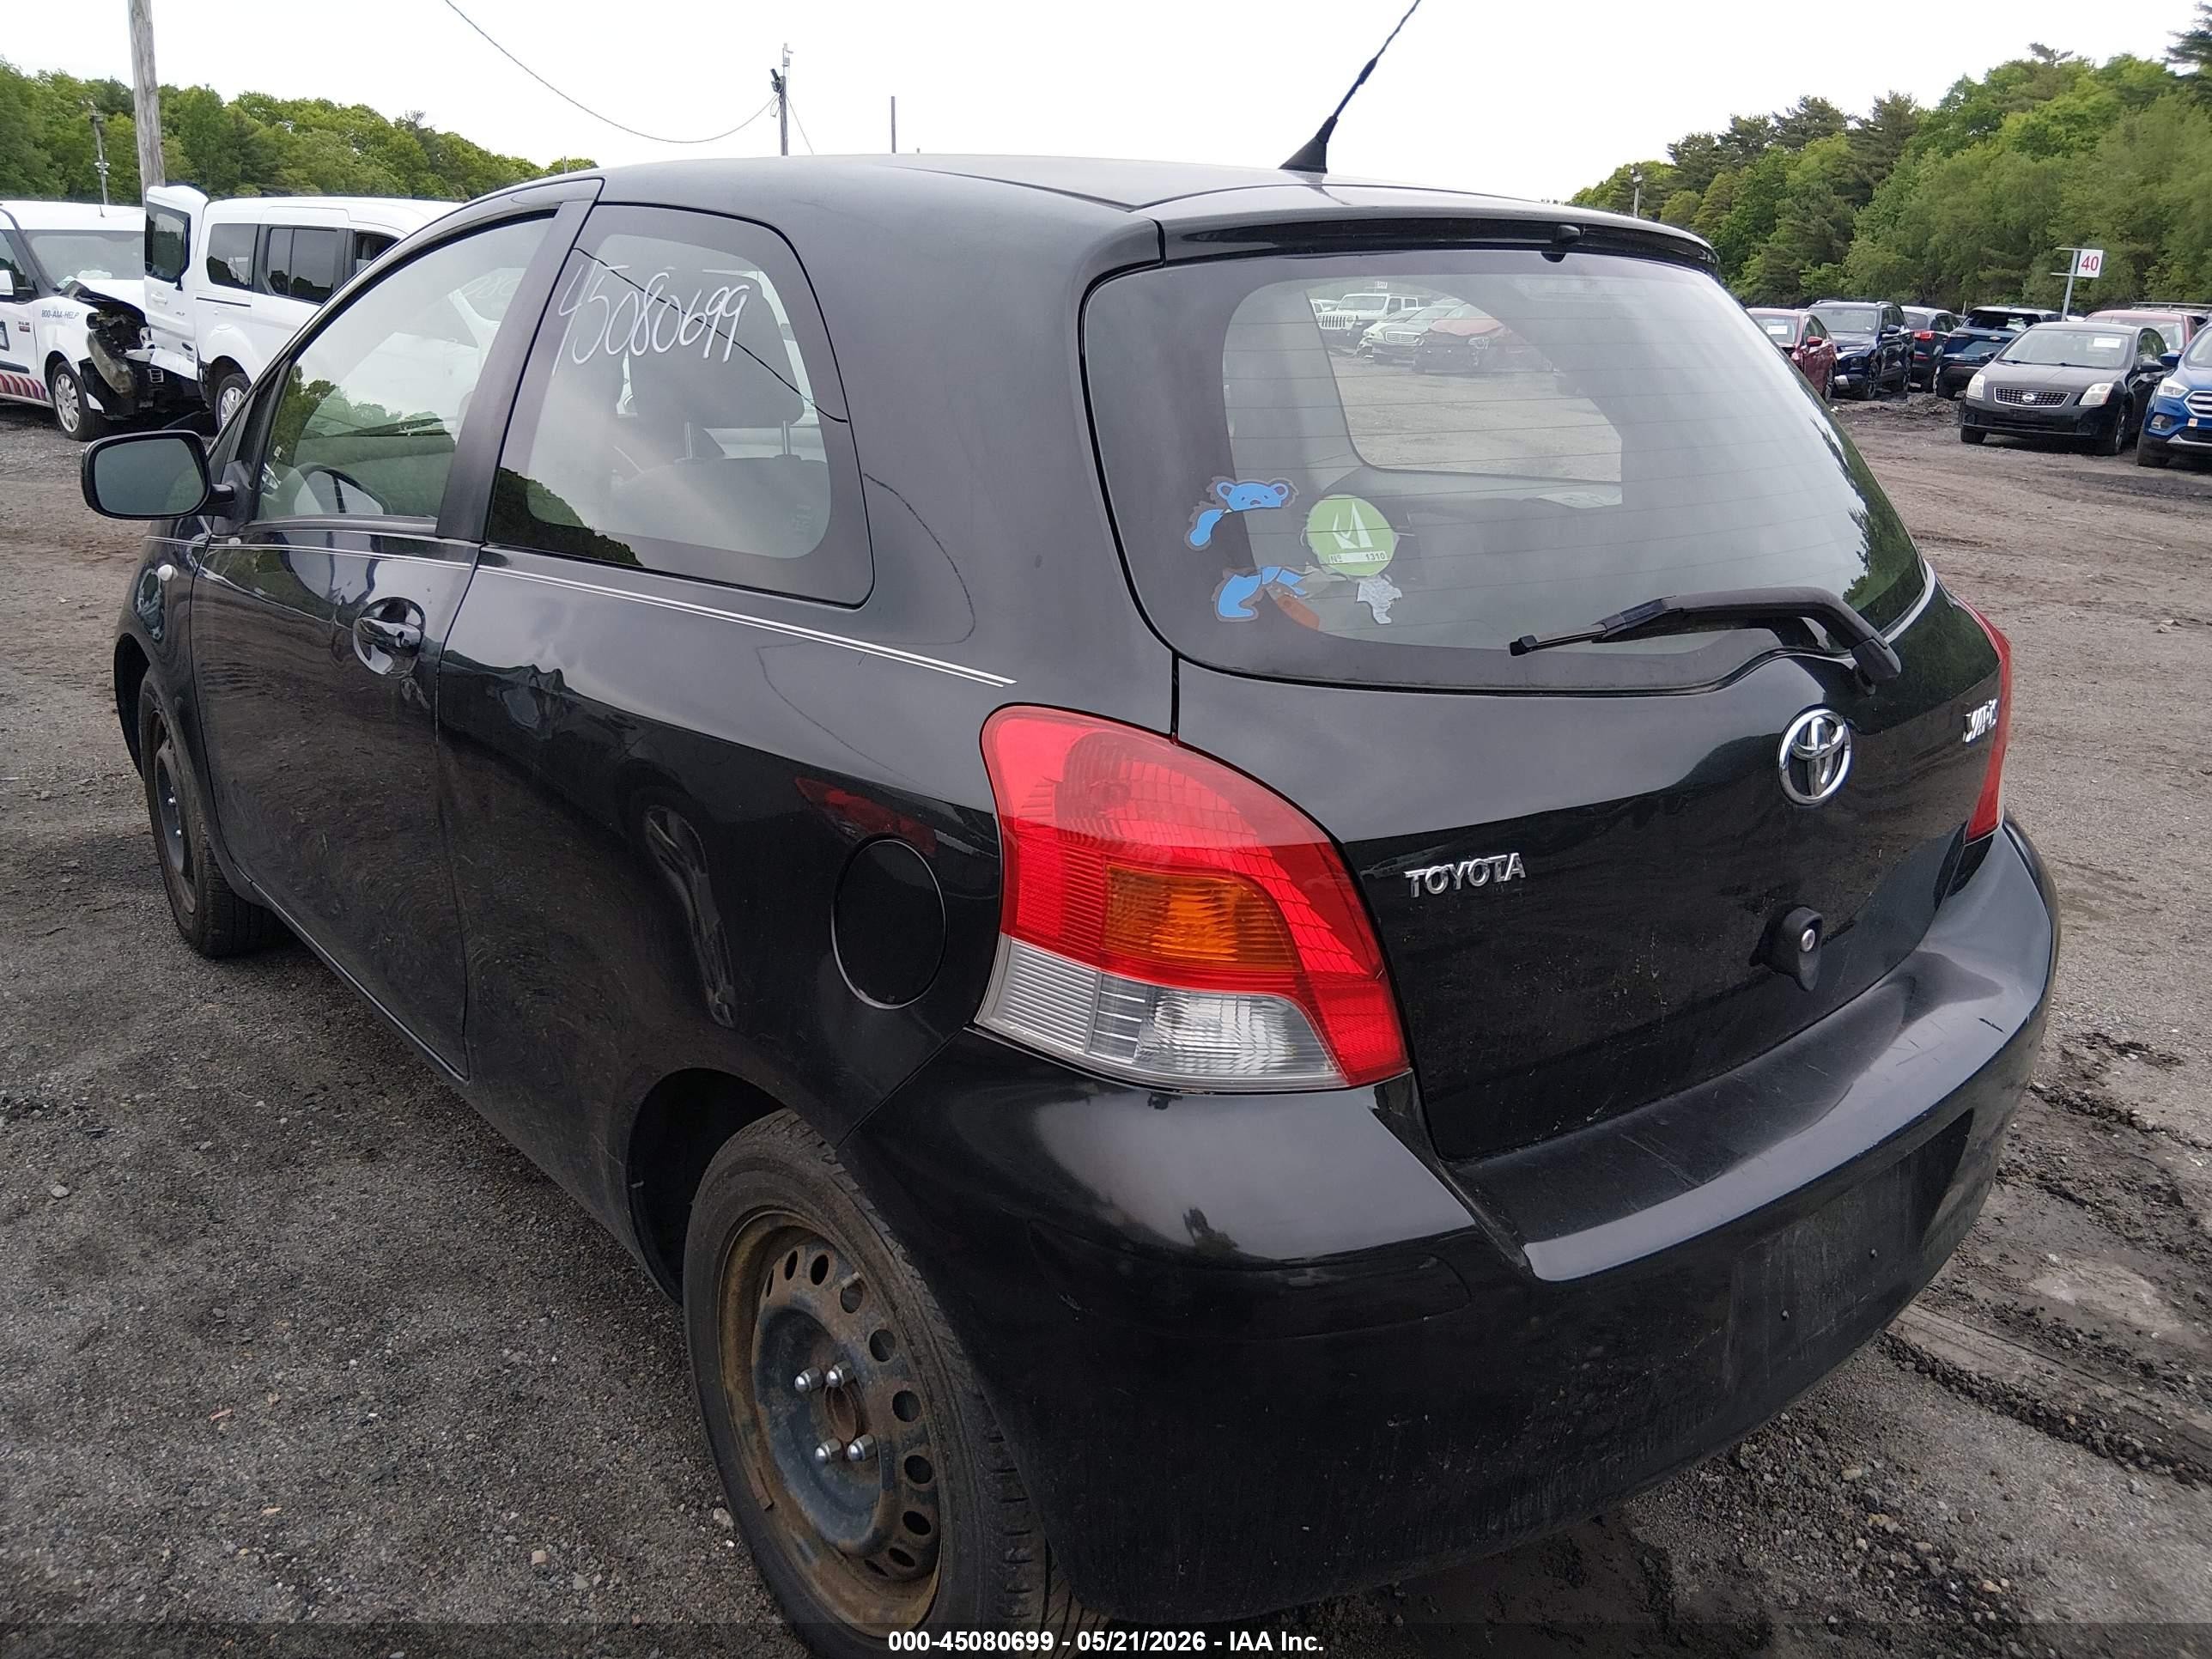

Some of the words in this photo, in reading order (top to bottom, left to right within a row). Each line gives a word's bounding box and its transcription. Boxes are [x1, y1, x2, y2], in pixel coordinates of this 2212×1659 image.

[2081, 255, 2100, 271] 40
[552, 262, 750, 377] 45080699
[1365, 551, 1386, 561] 1310
[1403, 852, 1527, 898] TOYOTA
